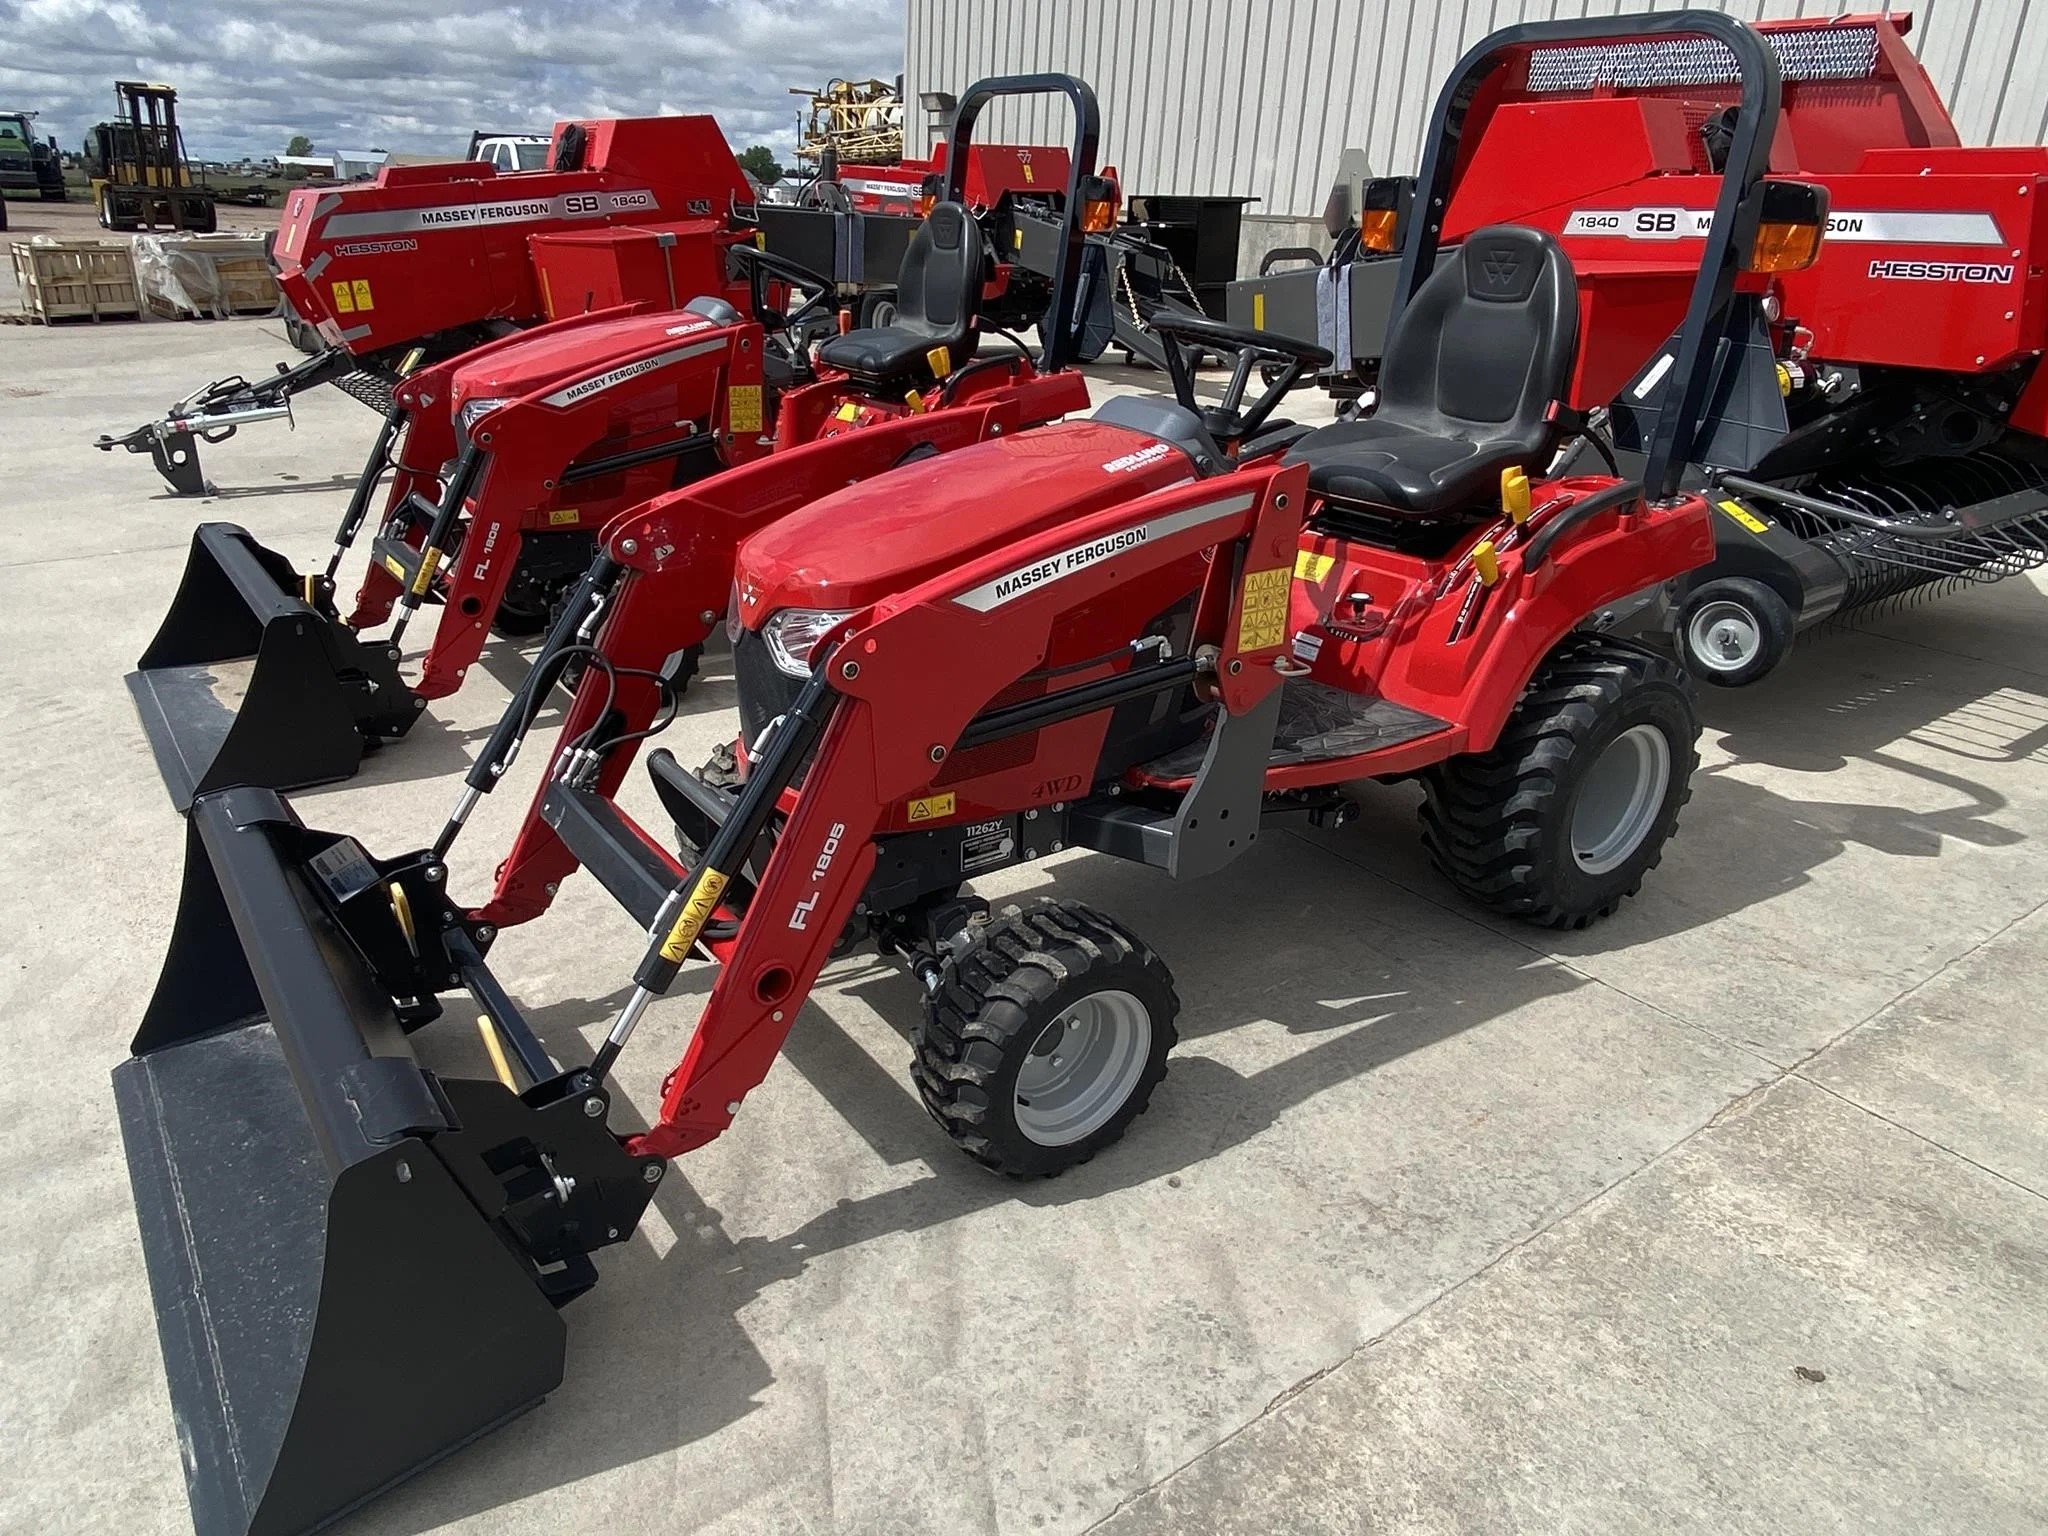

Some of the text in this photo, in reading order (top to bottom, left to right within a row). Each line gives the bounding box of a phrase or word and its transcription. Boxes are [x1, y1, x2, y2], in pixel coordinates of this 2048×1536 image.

[420, 194, 647, 225] MASSEY FERGUSON SB 1840
[1577, 212, 1676, 232] 1840 SB
[335, 239, 418, 257] HESSTON
[1868, 261, 2014, 283] HESSTON
[566, 359, 659, 400] MASSEY FERGUSON
[1102, 443, 1170, 474] REDLUND
[473, 521, 500, 580] FL 1805
[995, 527, 1147, 599] MASSEY FERGUSON
[1031, 774, 1082, 799] 4WD
[966, 819, 1003, 837] 11262Y
[788, 822, 846, 931] FL 1805
